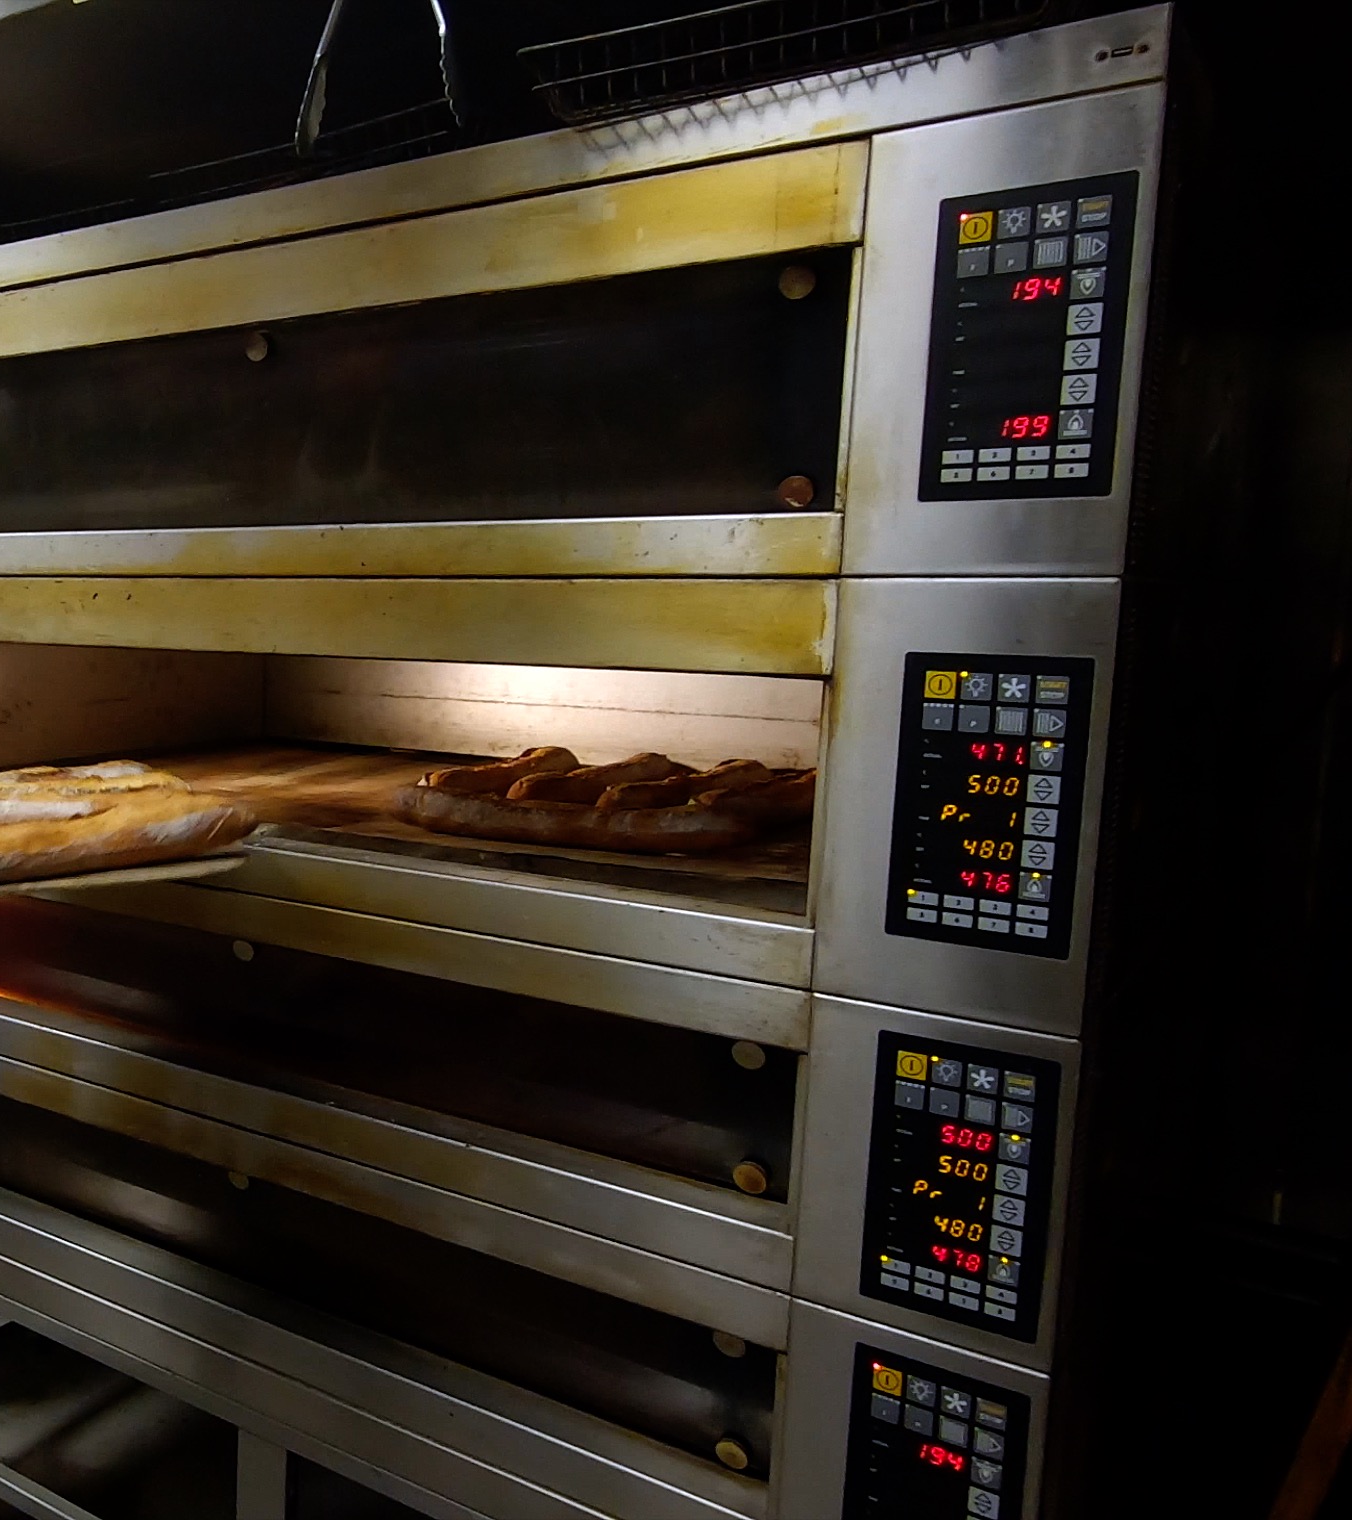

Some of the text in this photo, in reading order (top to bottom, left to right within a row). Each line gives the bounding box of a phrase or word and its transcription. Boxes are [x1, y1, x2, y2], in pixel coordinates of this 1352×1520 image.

[1012, 277, 1061, 300] 194
[1001, 415, 1049, 438] 199
[968, 774, 1020, 796] 500
[940, 804, 1017, 827] Pr 1
[963, 839, 1014, 860] 480
[961, 871, 1011, 893] 476
[941, 1125, 992, 1151] 500
[938, 1155, 988, 1182] 500
[912, 1180, 943, 1199] Pr
[978, 1196, 986, 1211] 1
[934, 1215, 983, 1242] 480
[932, 1245, 981, 1272] 478
[919, 1444, 964, 1471] 194
